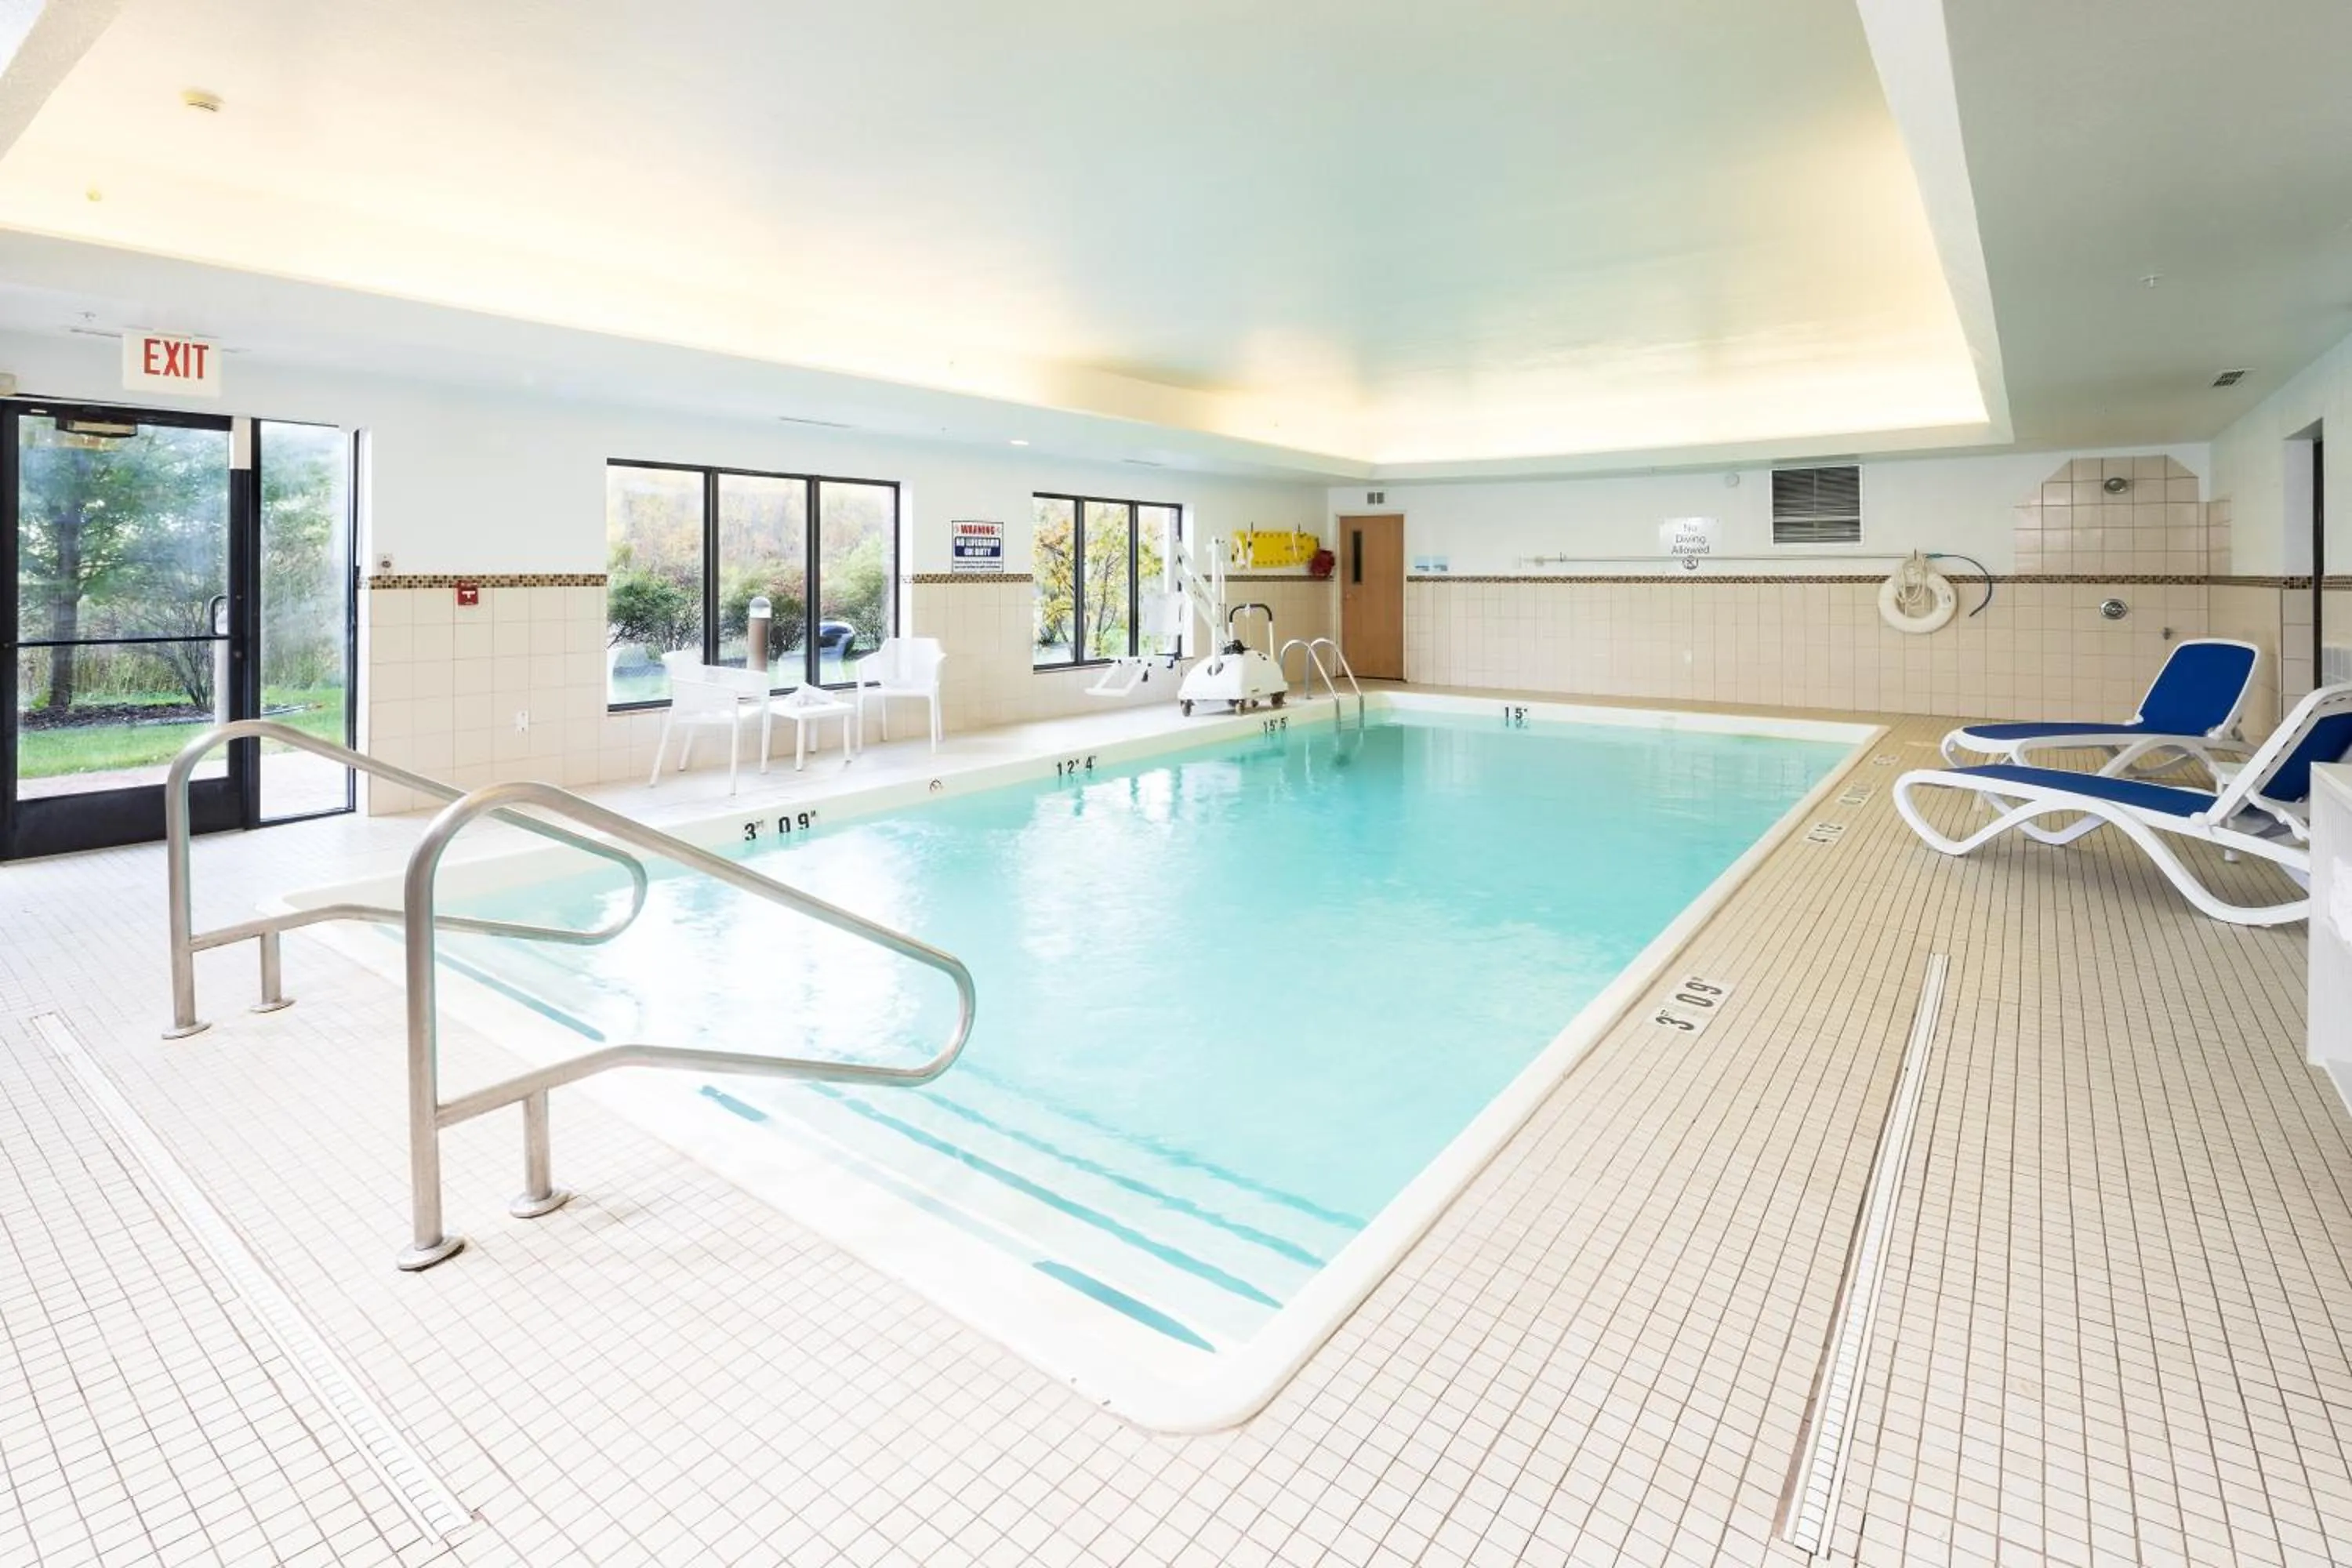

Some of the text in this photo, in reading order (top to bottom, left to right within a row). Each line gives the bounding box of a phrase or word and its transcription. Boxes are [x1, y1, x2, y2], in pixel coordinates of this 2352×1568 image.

[143, 338, 209, 379] EXIT
[960, 524, 995, 535] WARNING
[1675, 534, 1707, 546] Diving
[1671, 545, 1710, 554] Allowed
